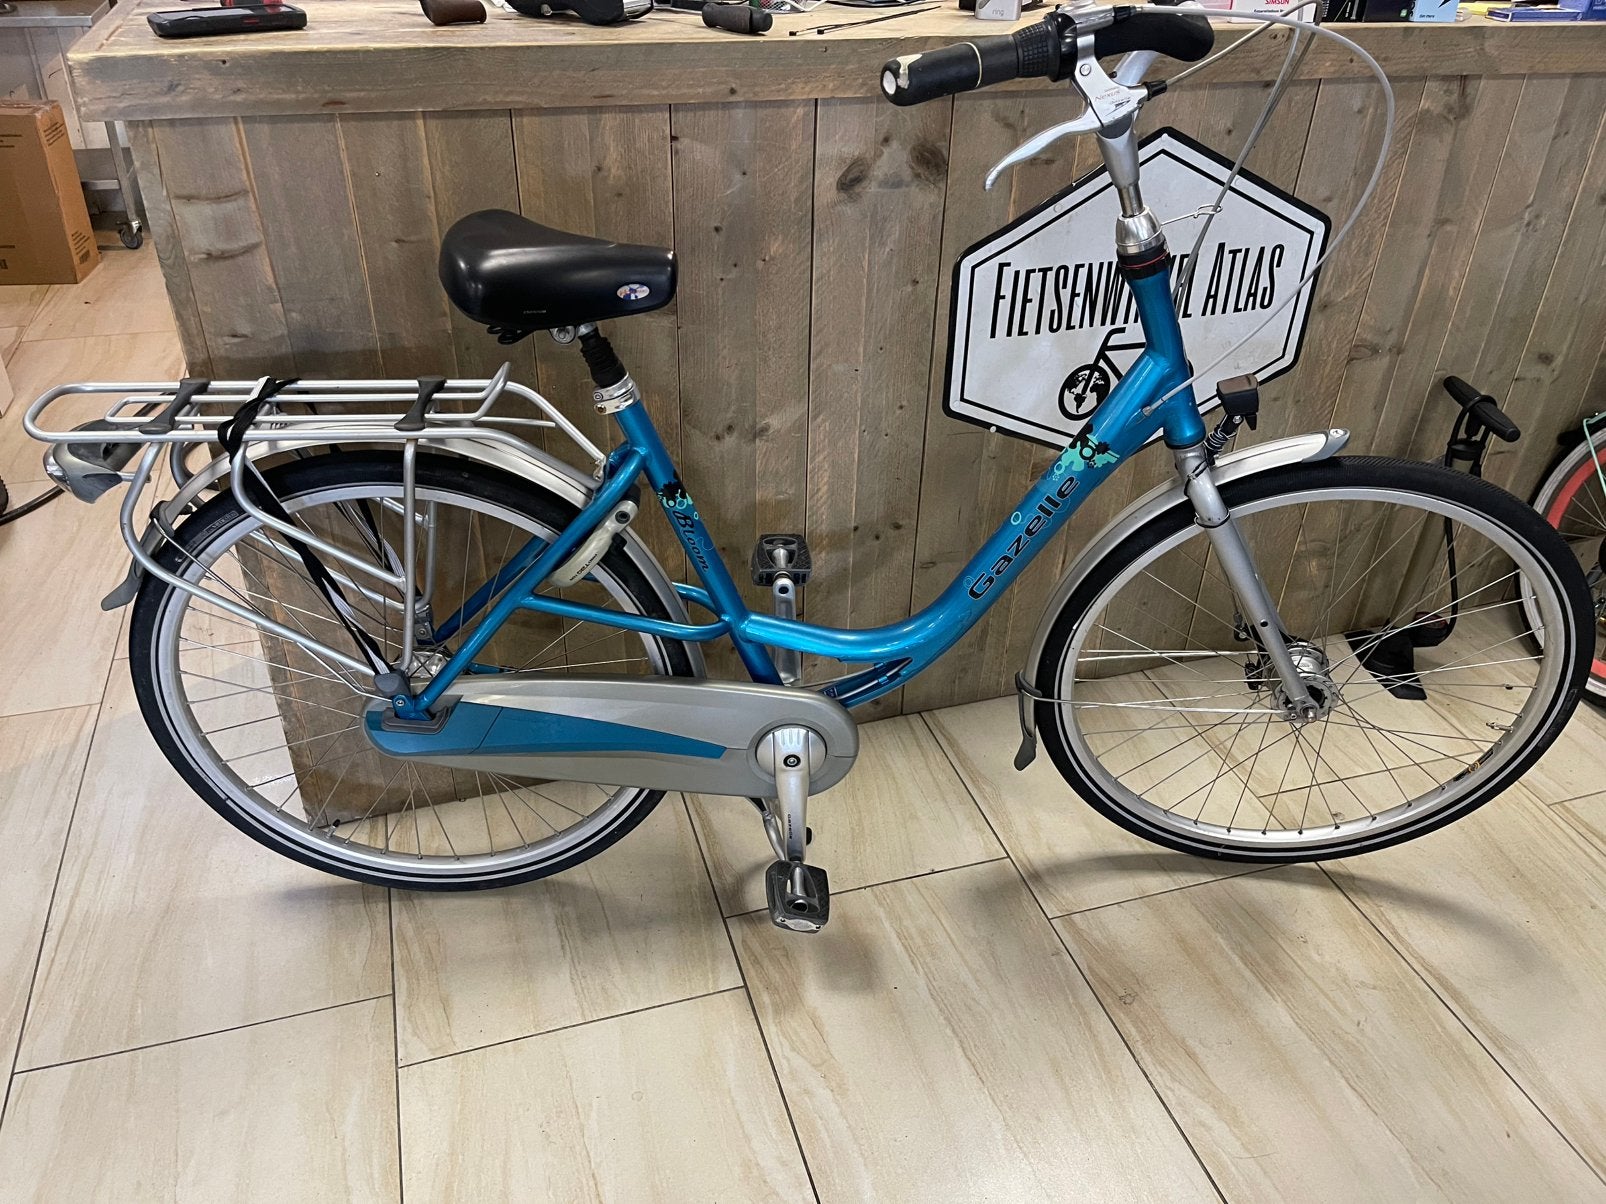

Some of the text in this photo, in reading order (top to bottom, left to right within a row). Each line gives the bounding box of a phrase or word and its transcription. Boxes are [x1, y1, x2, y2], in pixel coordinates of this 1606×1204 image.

[992, 8, 1005, 17] ring
[673, 511, 710, 573] Bloom
[968, 476, 1080, 600] Gazelle
